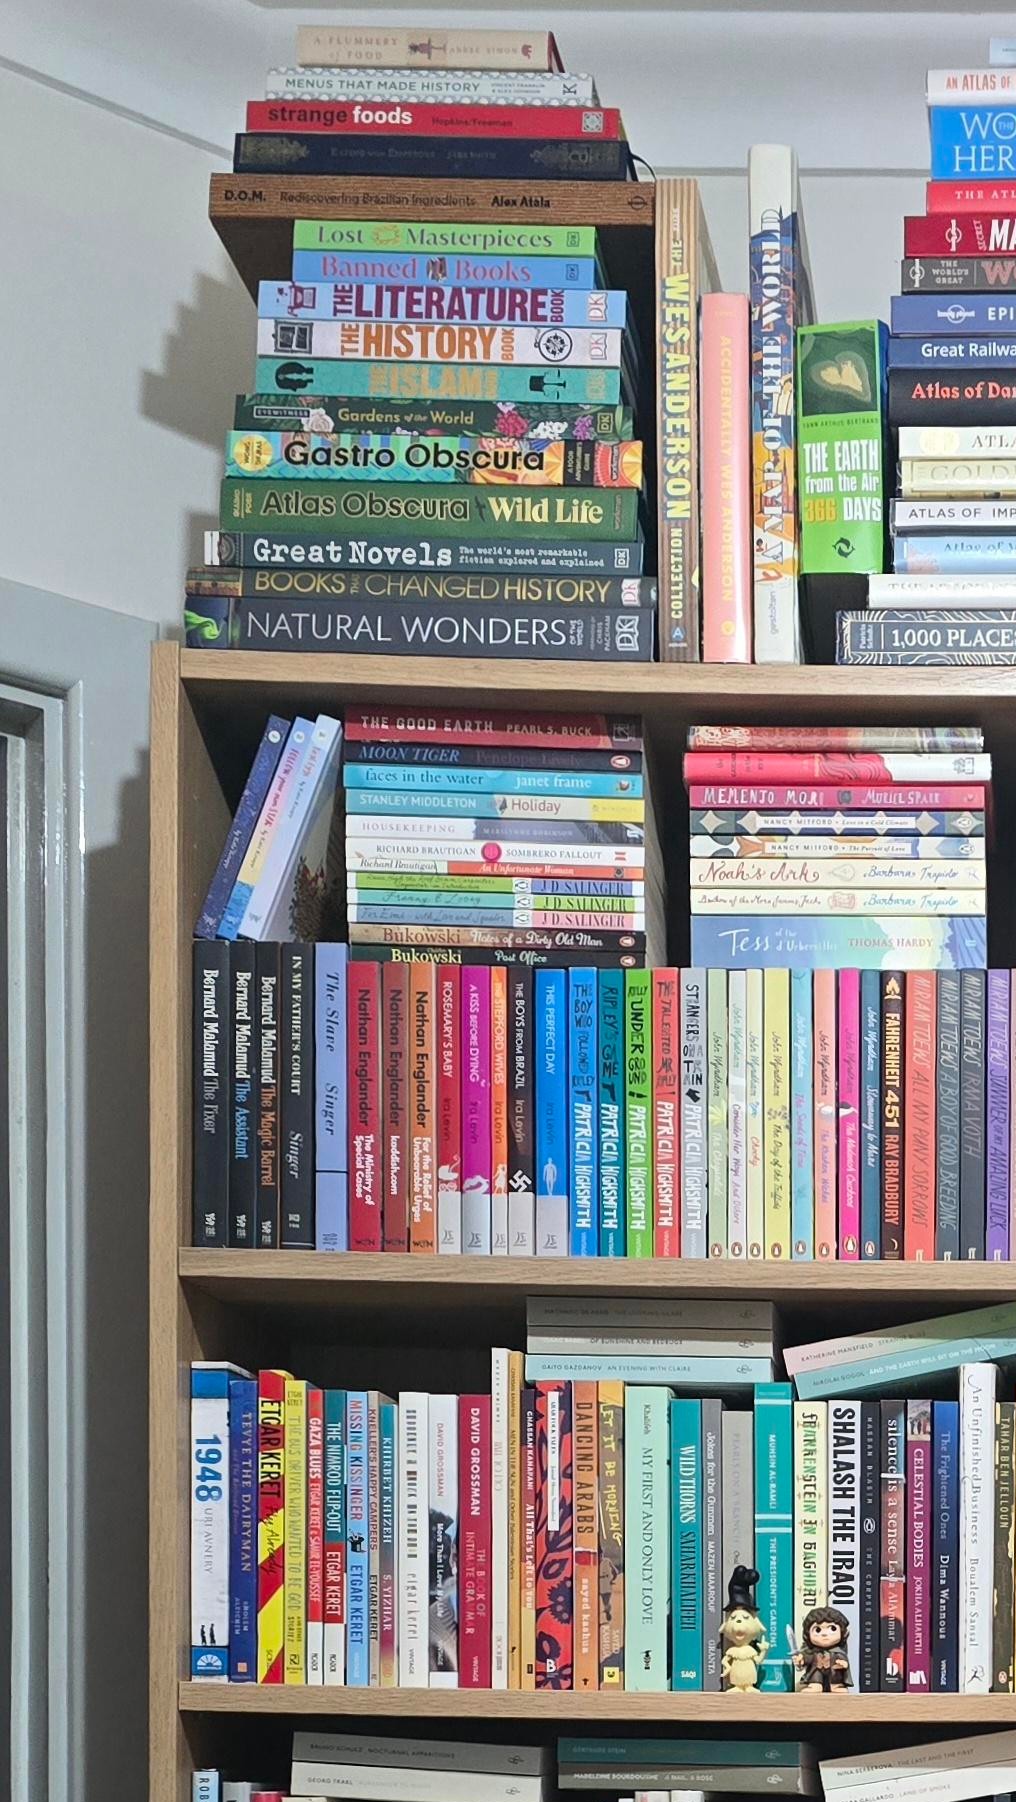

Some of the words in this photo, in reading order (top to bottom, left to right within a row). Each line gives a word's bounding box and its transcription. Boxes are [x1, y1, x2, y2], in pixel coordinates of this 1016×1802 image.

[285, 77, 336, 92] MENUS
[338, 78, 374, 92] THAT
[377, 79, 416, 93] MADE
[420, 80, 481, 94] HISTORY
[267, 104, 349, 127] strange
[352, 106, 413, 125] foods
[318, 226, 364, 246] Lost
[406, 228, 554, 250] Masterpieces
[321, 255, 417, 280] Banned
[455, 258, 532, 282] Books
[333, 284, 353, 317] THE
[354, 284, 550, 323] LITERATURE
[550, 289, 565, 322] BOOK
[664, 272, 690, 342] WES
[921, 342, 966, 359] Great
[912, 382, 958, 399] Atlas
[964, 381, 982, 399] of
[665, 348, 691, 518] ANDERSON
[284, 442, 395, 471] Gastro
[405, 443, 545, 471] Obscura
[803, 441, 829, 471] THE
[835, 439, 878, 470] EARTH
[805, 474, 831, 494] from
[837, 474, 856, 492] the
[861, 474, 879, 491] Air
[262, 491, 337, 518] Atlas
[342, 492, 470, 521] Obscura
[488, 495, 549, 523] Wild
[556, 498, 603, 524] Life
[804, 499, 837, 520] 366
[842, 498, 881, 522] DAYS
[254, 539, 342, 563] Great
[350, 541, 452, 566] Novels
[670, 529, 683, 618] COLLECTION
[248, 611, 392, 642] NATURAL
[402, 615, 568, 646] WONDERS
[892, 628, 942, 649] 1,000
[359, 794, 408, 807] STANLEY
[411, 795, 476, 809] MIDDLETON
[511, 798, 561, 815] Holiday
[719, 929, 770, 957] Tess
[203, 969, 218, 1015] Bernard
[358, 989, 370, 1046] Nathan
[203, 1018, 218, 1076] Malamud
[885, 1013, 899, 1086] FAHRENHEIT
[355, 1050, 370, 1126] Englander
[884, 1093, 899, 1127] 451
[574, 1103, 592, 1161] PATRICIA
[884, 1133, 899, 1155] RAY
[575, 1166, 592, 1229] HIGHSMITH
[884, 1158, 899, 1225] BRADBURY
[575, 1402, 592, 1472] DANCING
[834, 1408, 855, 1500] SHALASH
[195, 1435, 222, 1502] 1948
[576, 1478, 594, 1533] ARABS
[834, 1506, 855, 1543] THE
[832, 1550, 855, 1605] IRAQI
